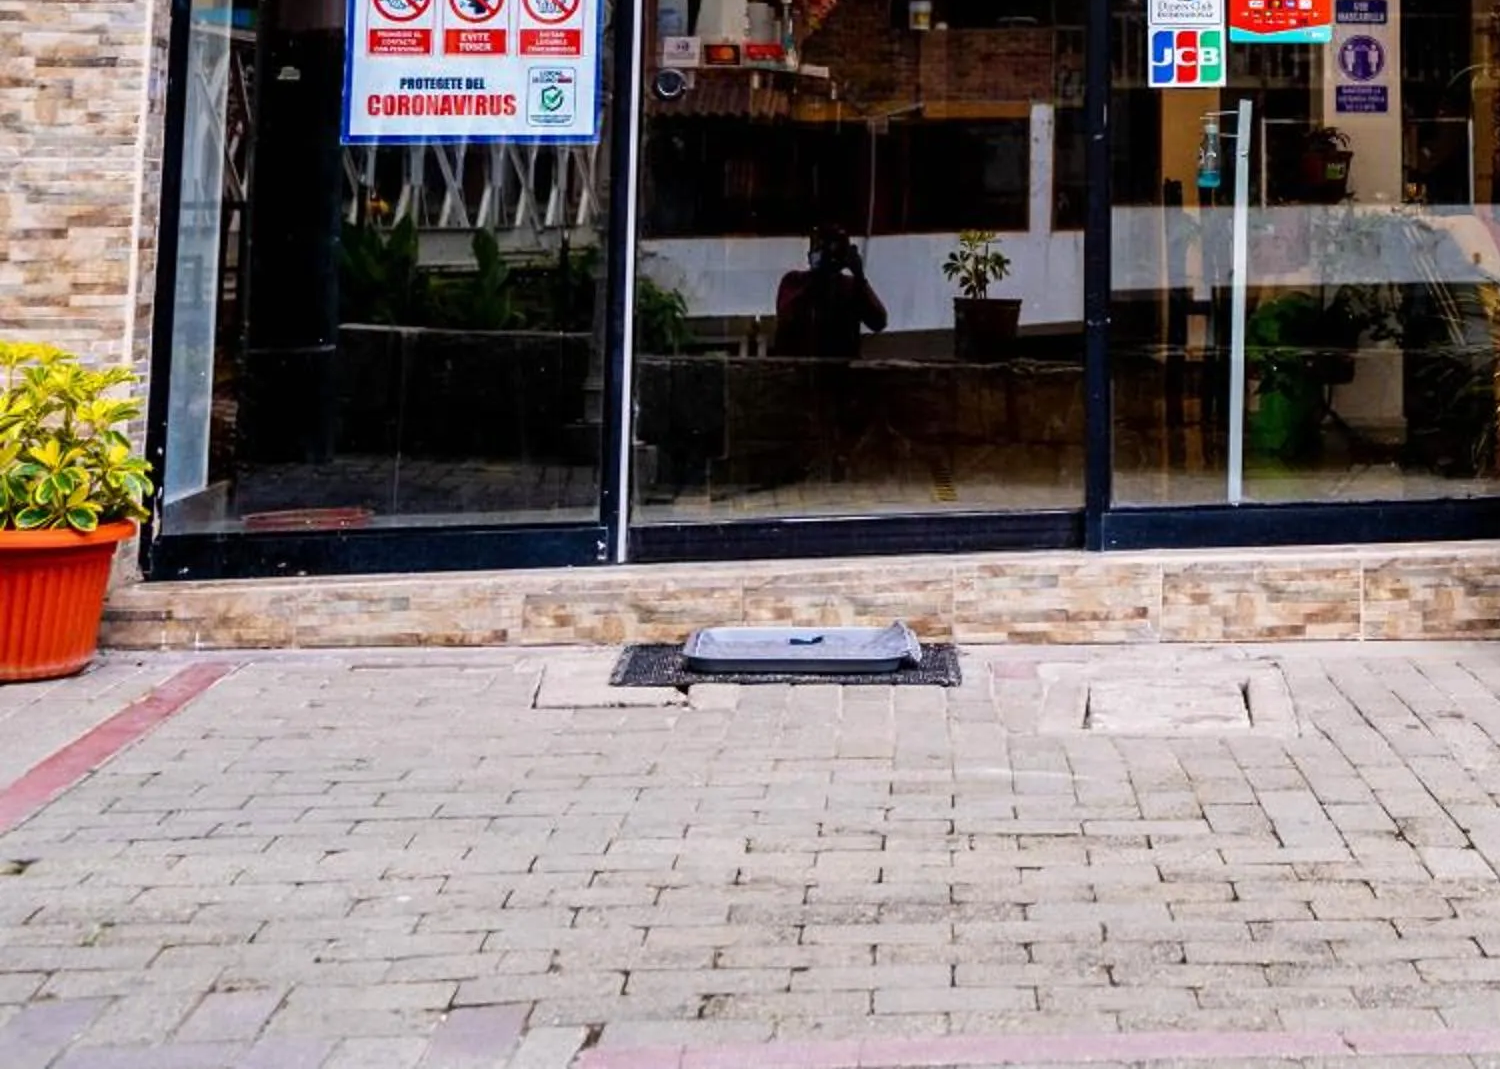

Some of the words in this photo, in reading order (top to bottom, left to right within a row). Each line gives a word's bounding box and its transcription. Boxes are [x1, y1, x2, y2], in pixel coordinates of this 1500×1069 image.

[460, 32, 490, 41] EVITE
[1152, 46, 1219, 66] JCB
[465, 78, 486, 90] DEL
[367, 94, 517, 117] CORONAVIRUS
